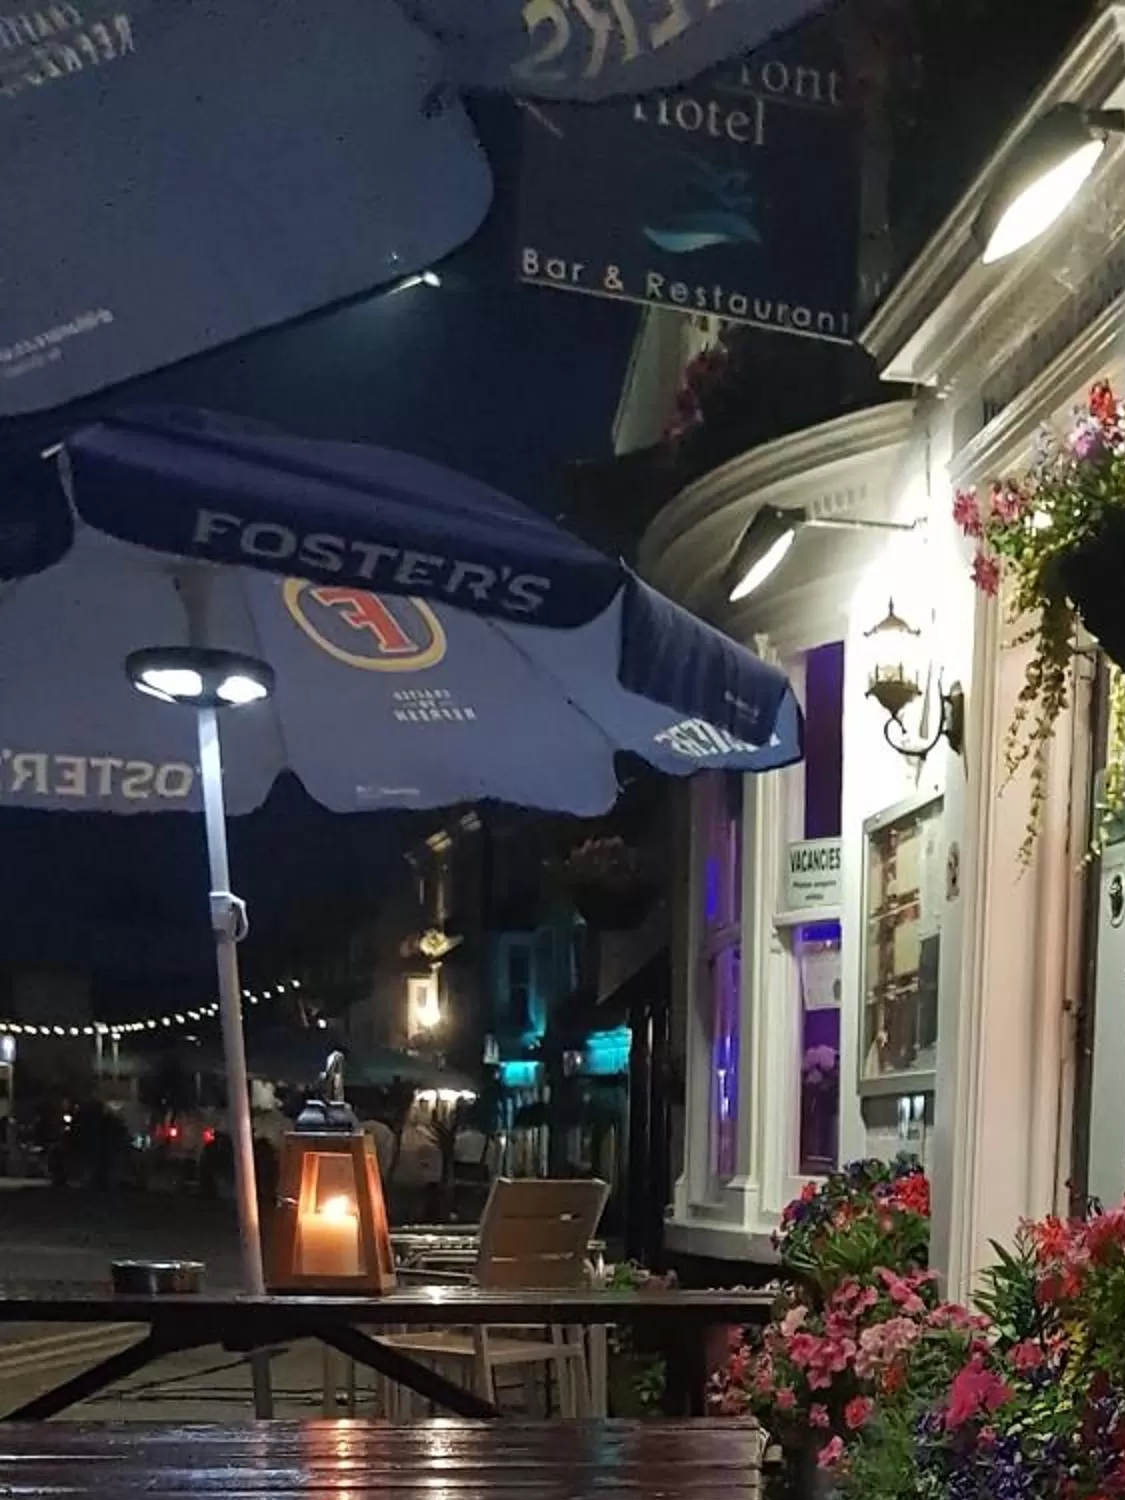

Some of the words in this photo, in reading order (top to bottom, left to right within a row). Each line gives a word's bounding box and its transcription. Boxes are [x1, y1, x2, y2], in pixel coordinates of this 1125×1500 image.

[522, 248, 586, 282] Bar
[604, 264, 624, 292] &
[193, 507, 551, 613] FOSTER'S
[790, 848, 841, 873] VACANCIES
